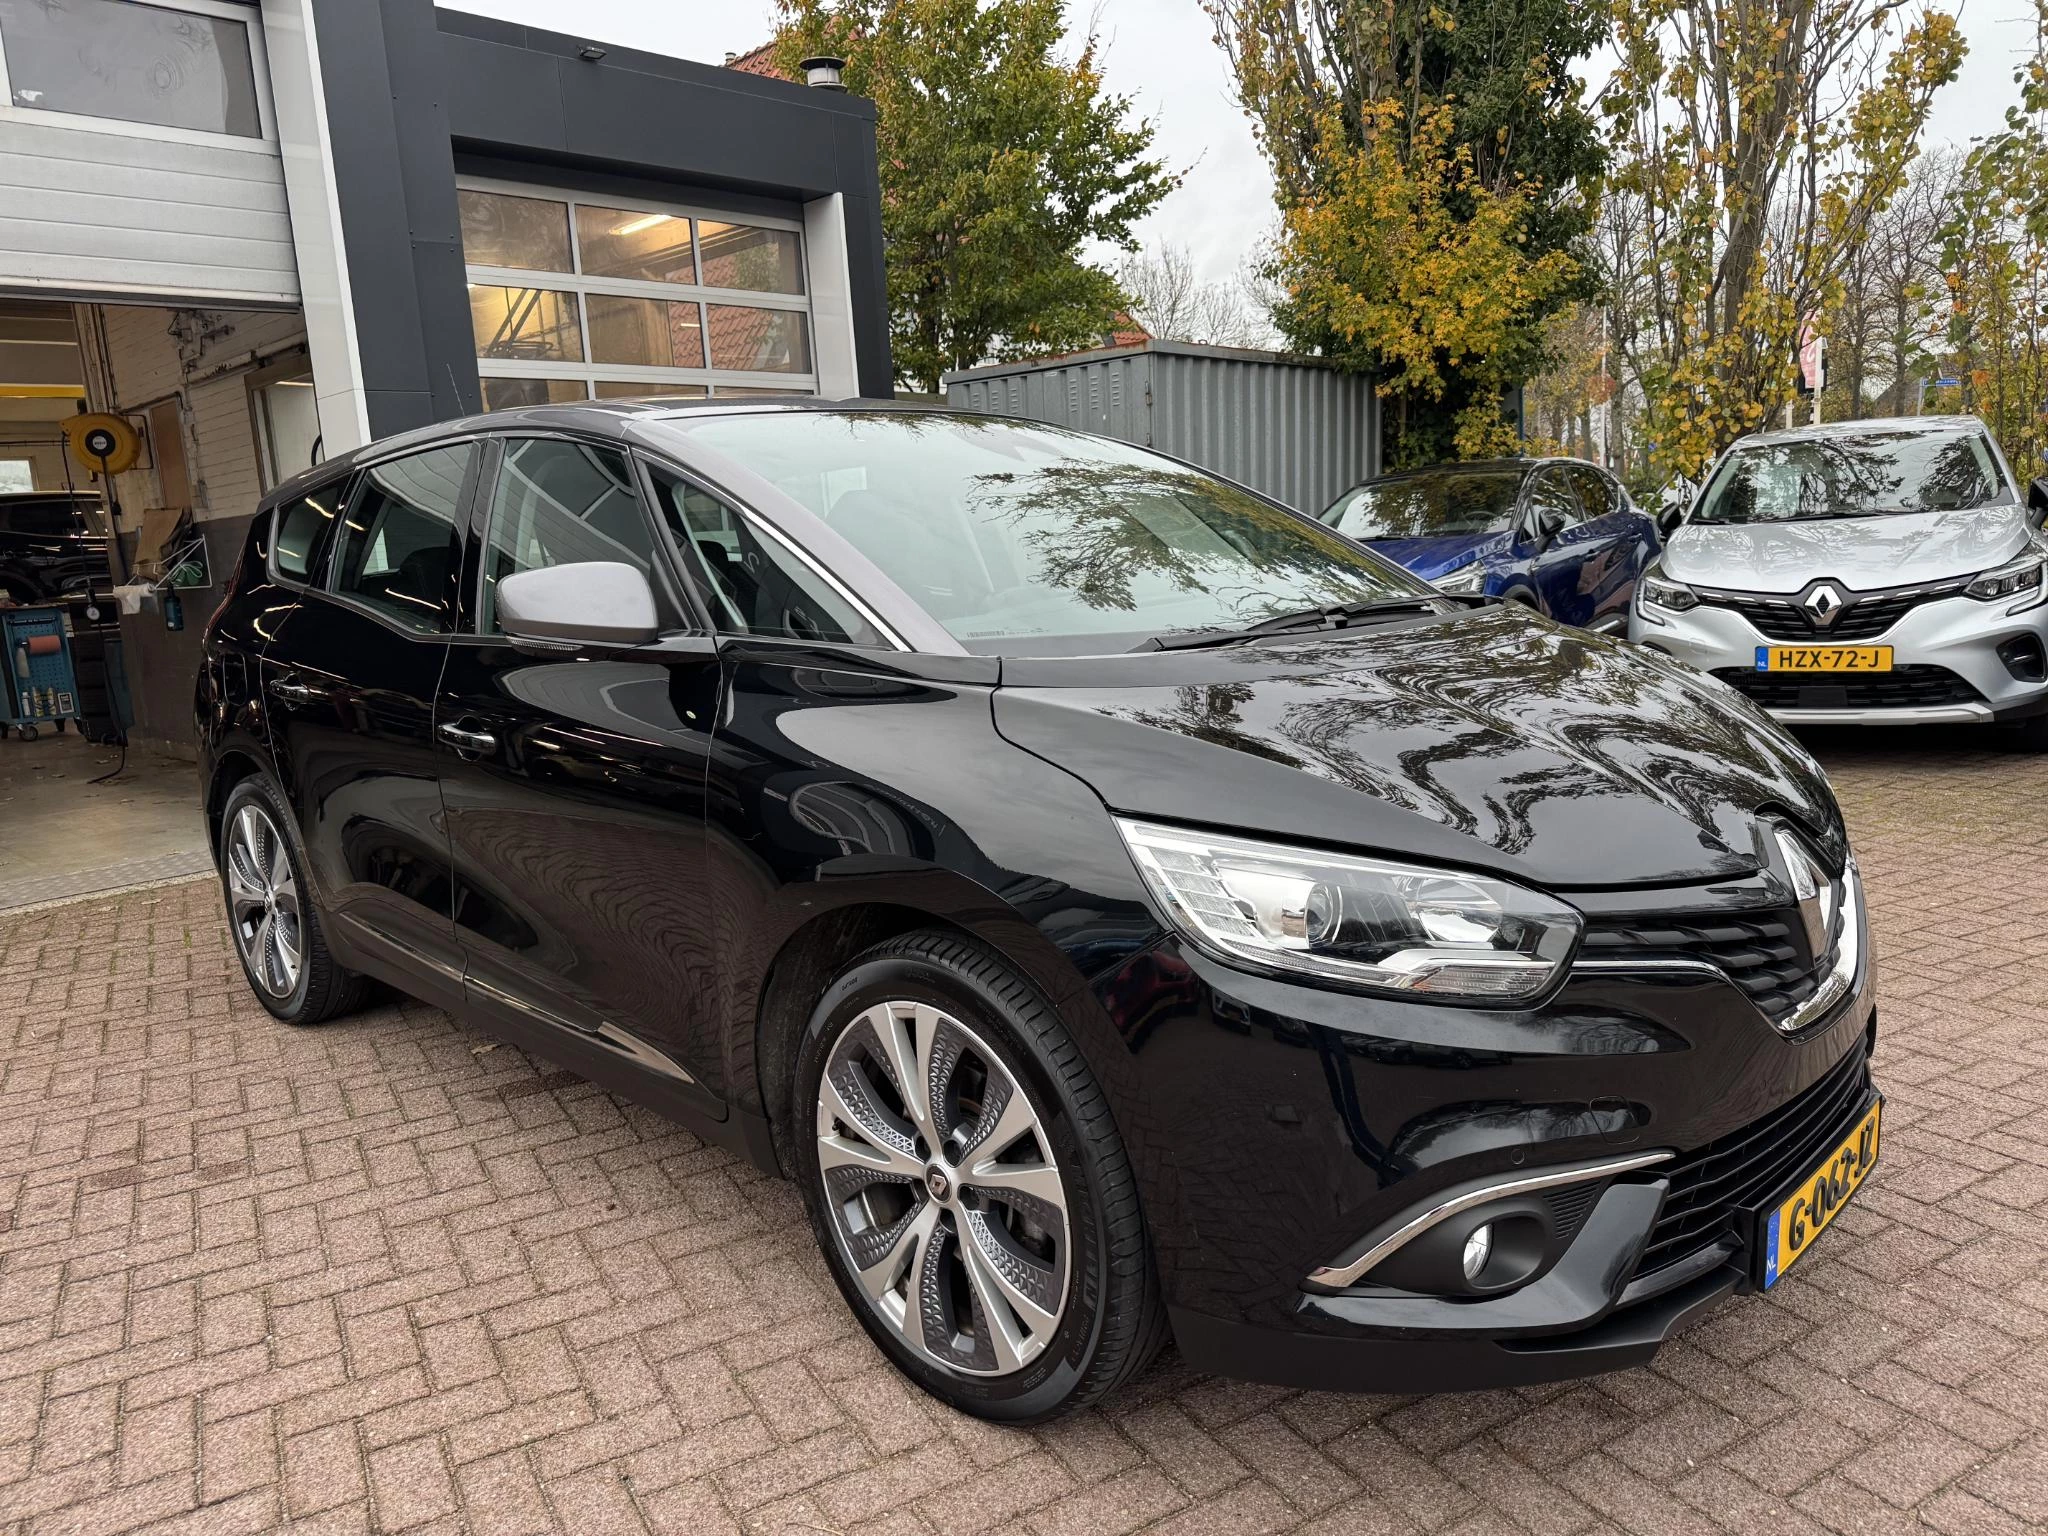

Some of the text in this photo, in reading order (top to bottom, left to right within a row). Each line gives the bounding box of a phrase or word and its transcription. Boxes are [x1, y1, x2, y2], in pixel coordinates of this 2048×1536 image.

[1779, 650, 1879, 668] HZX-72-J
[1788, 1115, 1876, 1251] G-062-JZ
[1766, 1255, 1777, 1275] NL
